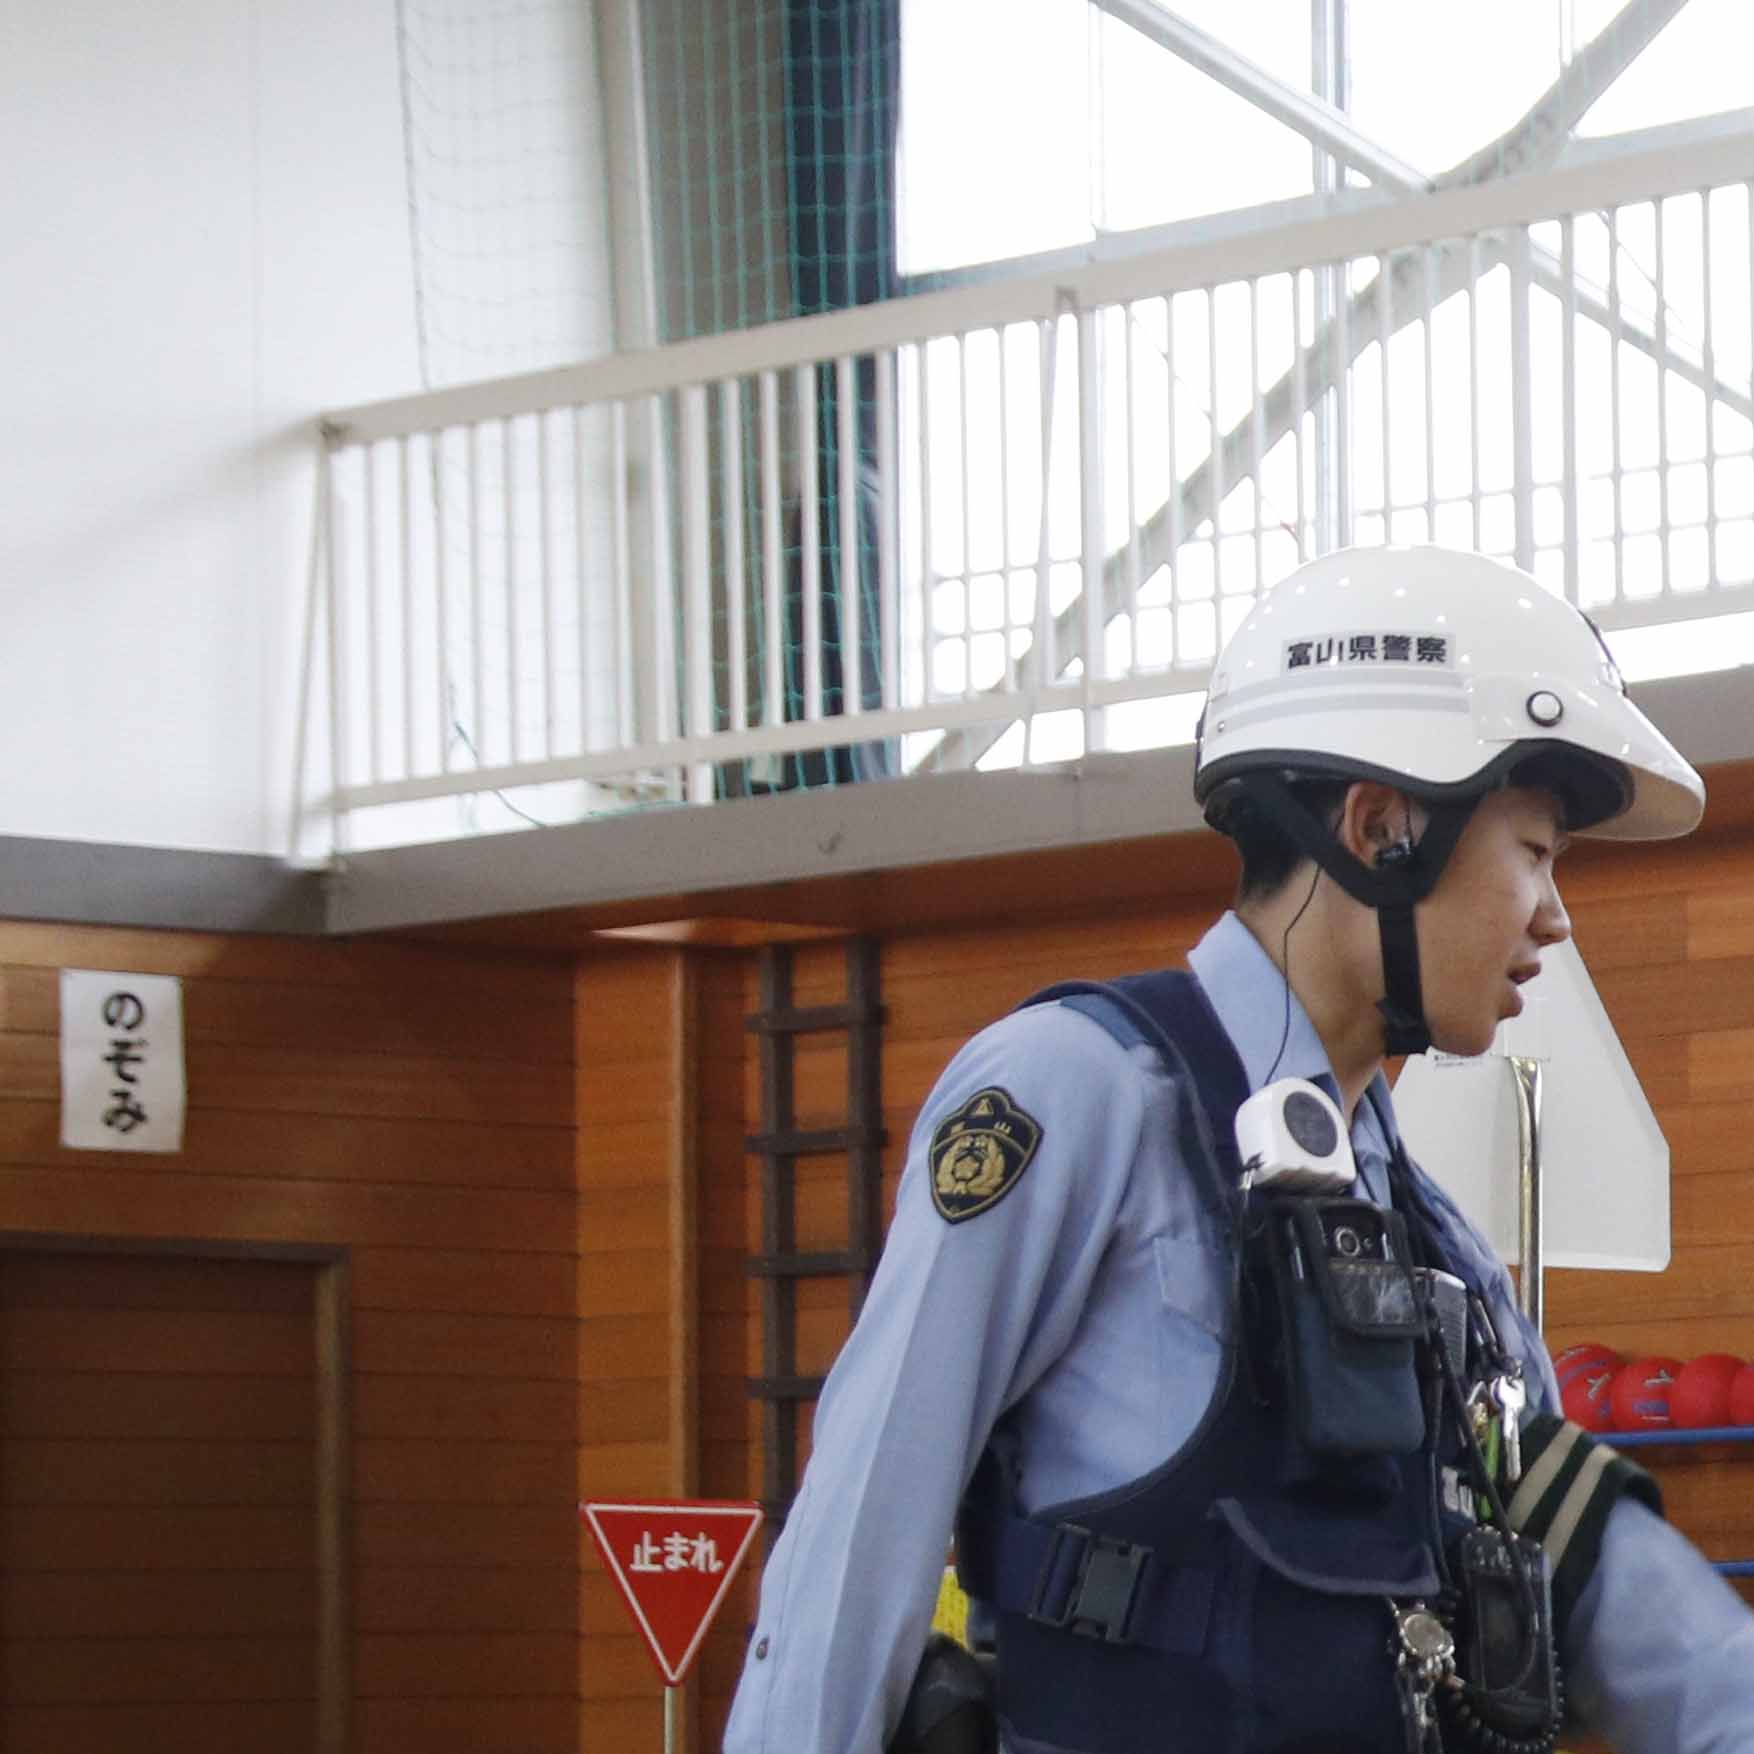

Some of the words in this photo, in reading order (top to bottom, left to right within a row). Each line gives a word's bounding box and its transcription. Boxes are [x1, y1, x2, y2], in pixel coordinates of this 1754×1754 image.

[1287, 634, 1447, 670] 富山県警察
[629, 1530, 724, 1573] 止まれ
